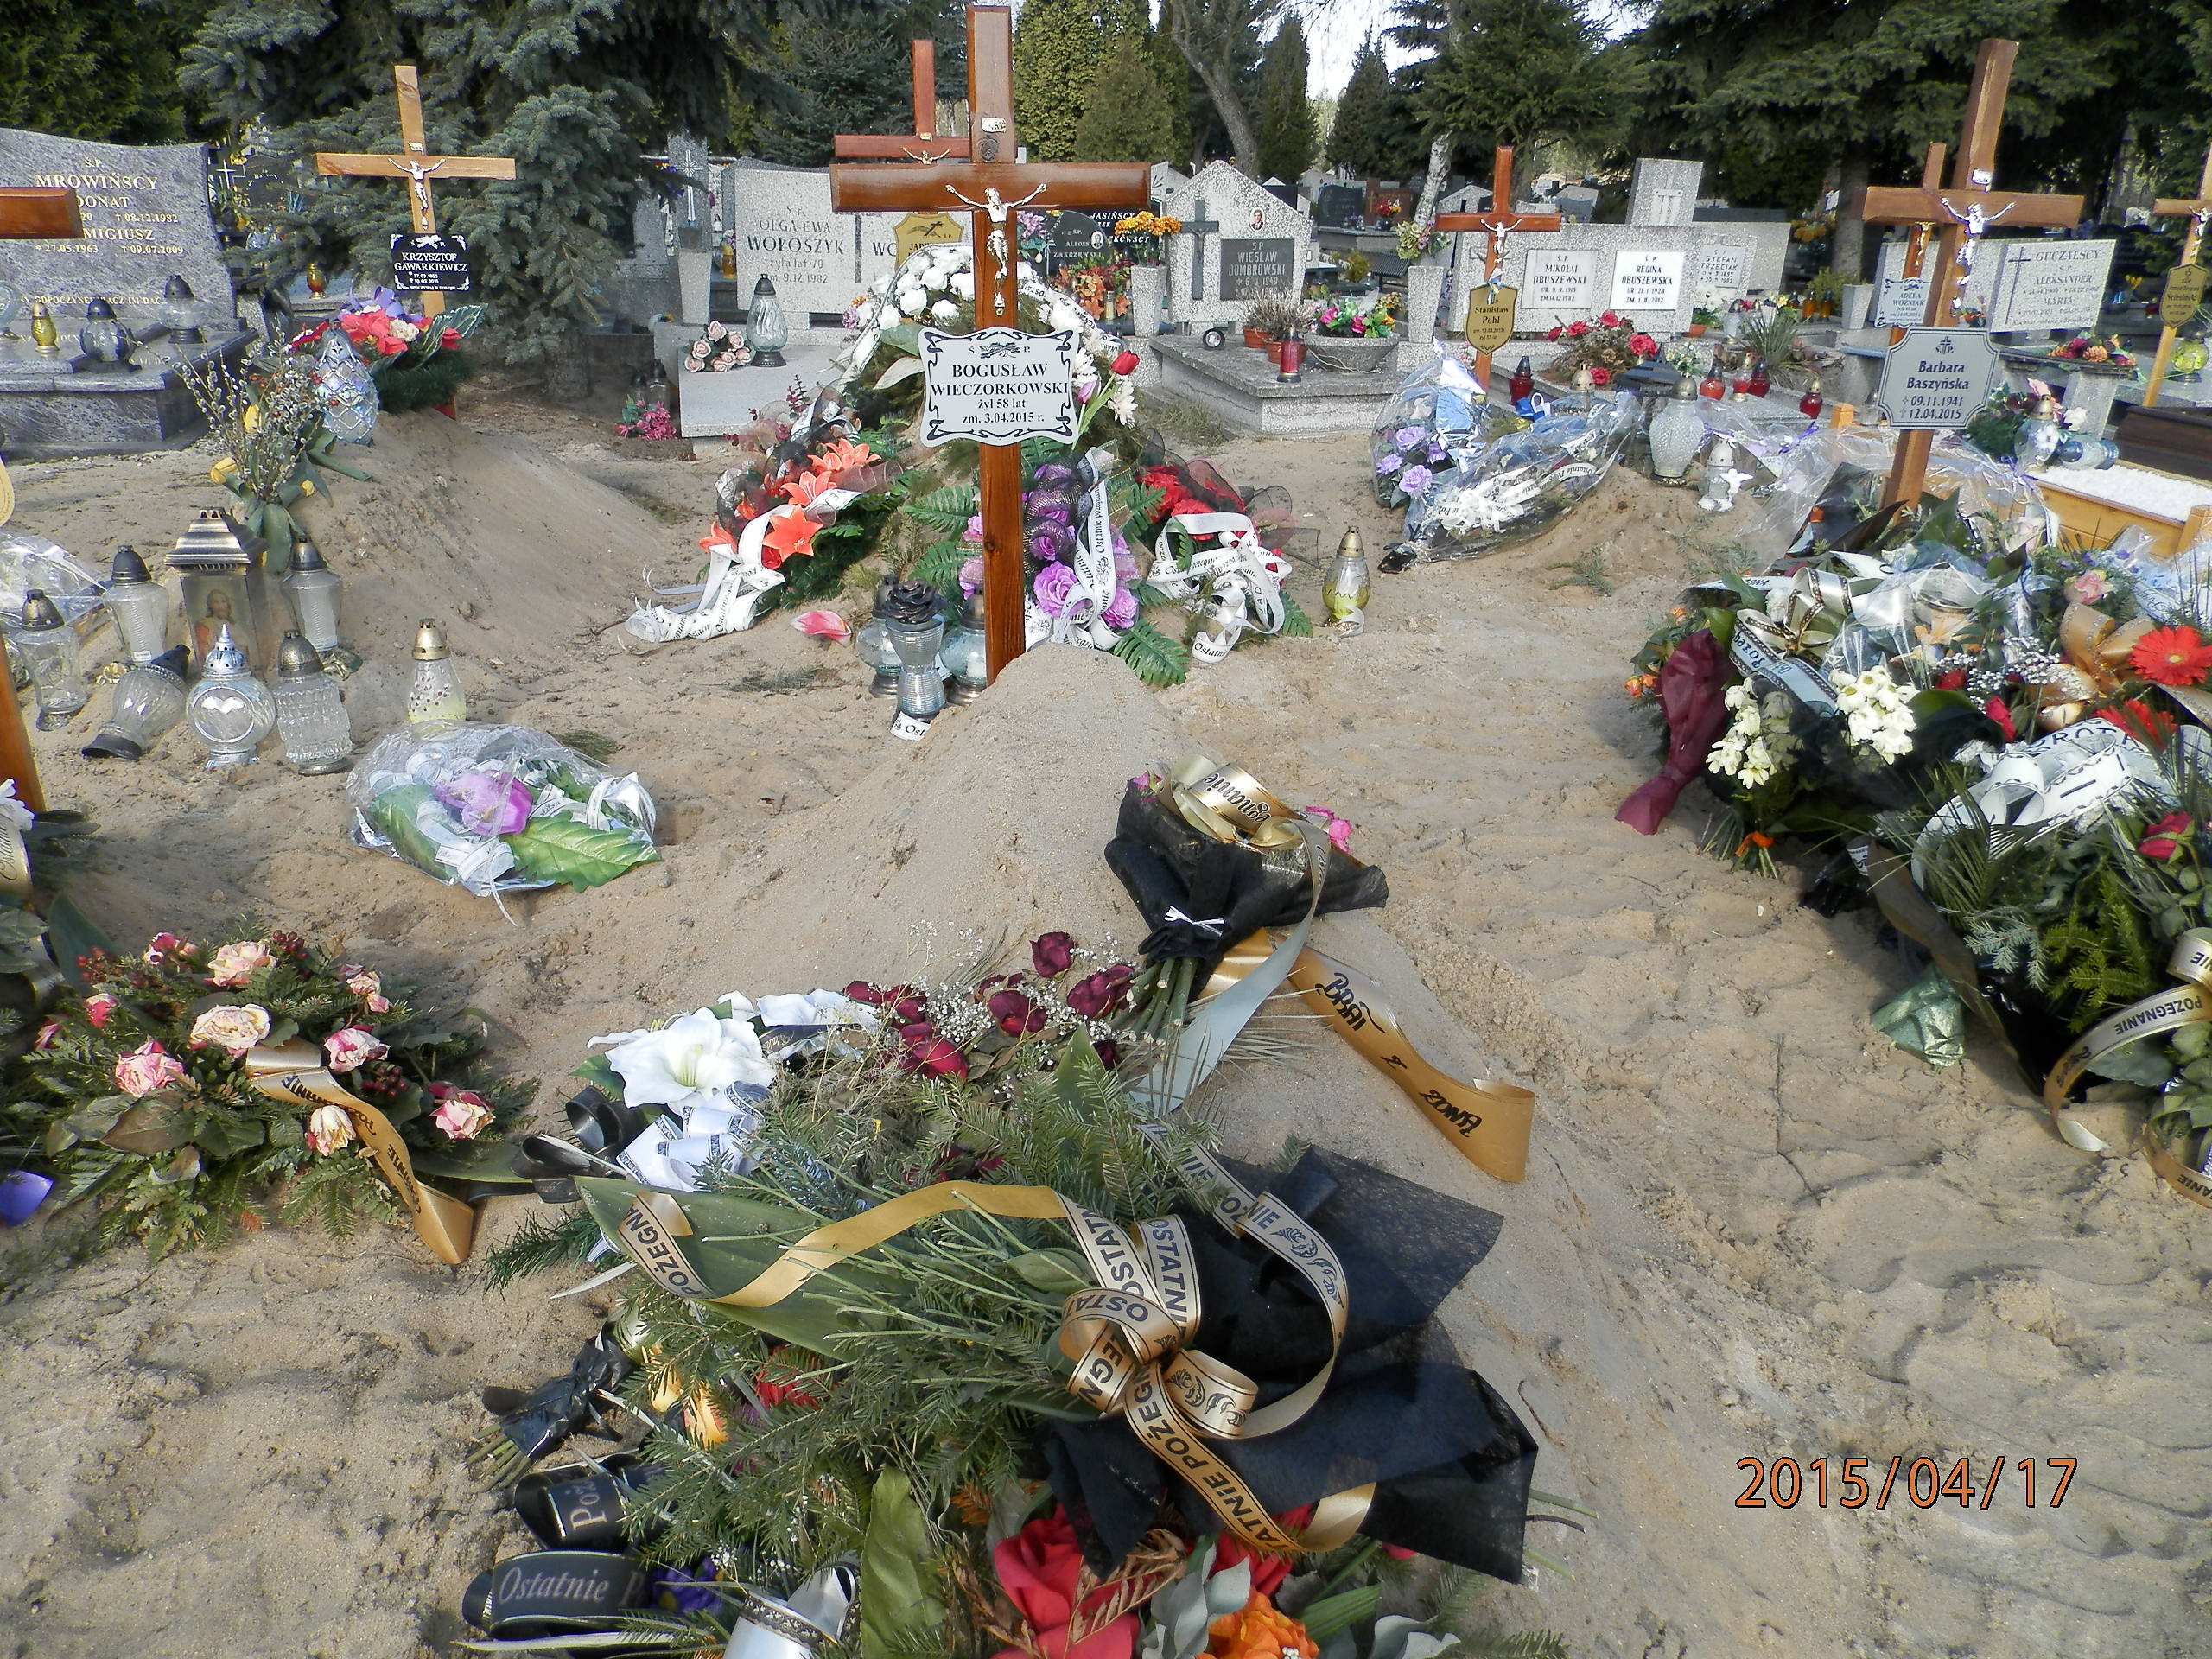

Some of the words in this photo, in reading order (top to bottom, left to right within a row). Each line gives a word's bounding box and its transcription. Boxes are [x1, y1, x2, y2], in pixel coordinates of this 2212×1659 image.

[35, 172, 158, 190] MROWIŃSCY
[124, 213, 179, 224] 08.12.1982
[760, 219, 798, 232] OLGA
[803, 220, 831, 234] EWA
[44, 243, 99, 253] 27.05.1963
[747, 235, 844, 255] WOŁOSZYK
[402, 252, 458, 262] KRZYSZTOF
[394, 262, 468, 272] GAWARKIEWICZ
[1229, 263, 1286, 276] DOMBROWSKI
[1534, 275, 1586, 284] OBUSZEWSKI
[1622, 276, 1672, 285] OBUSZEWSKA
[1483, 315, 1500, 324] Pohl
[952, 363, 1048, 378] BOGUSŁAW
[1918, 360, 1965, 373] Barbara
[930, 382, 1068, 397] WIECZORKOWSKI
[1907, 377, 1969, 392] Baszyńska
[977, 398, 995, 411] żył
[997, 398, 1009, 408] 58
[1012, 398, 1026, 408] lat
[1910, 395, 1963, 407] 09.11.1941
[962, 416, 982, 424] zm.
[984, 411, 1034, 423] 3.04.2015
[1909, 408, 1961, 420] 12.04.2015
[2113, 995, 2203, 1035] POŻEGNANIE
[499, 1565, 608, 1604] Ostatnie
